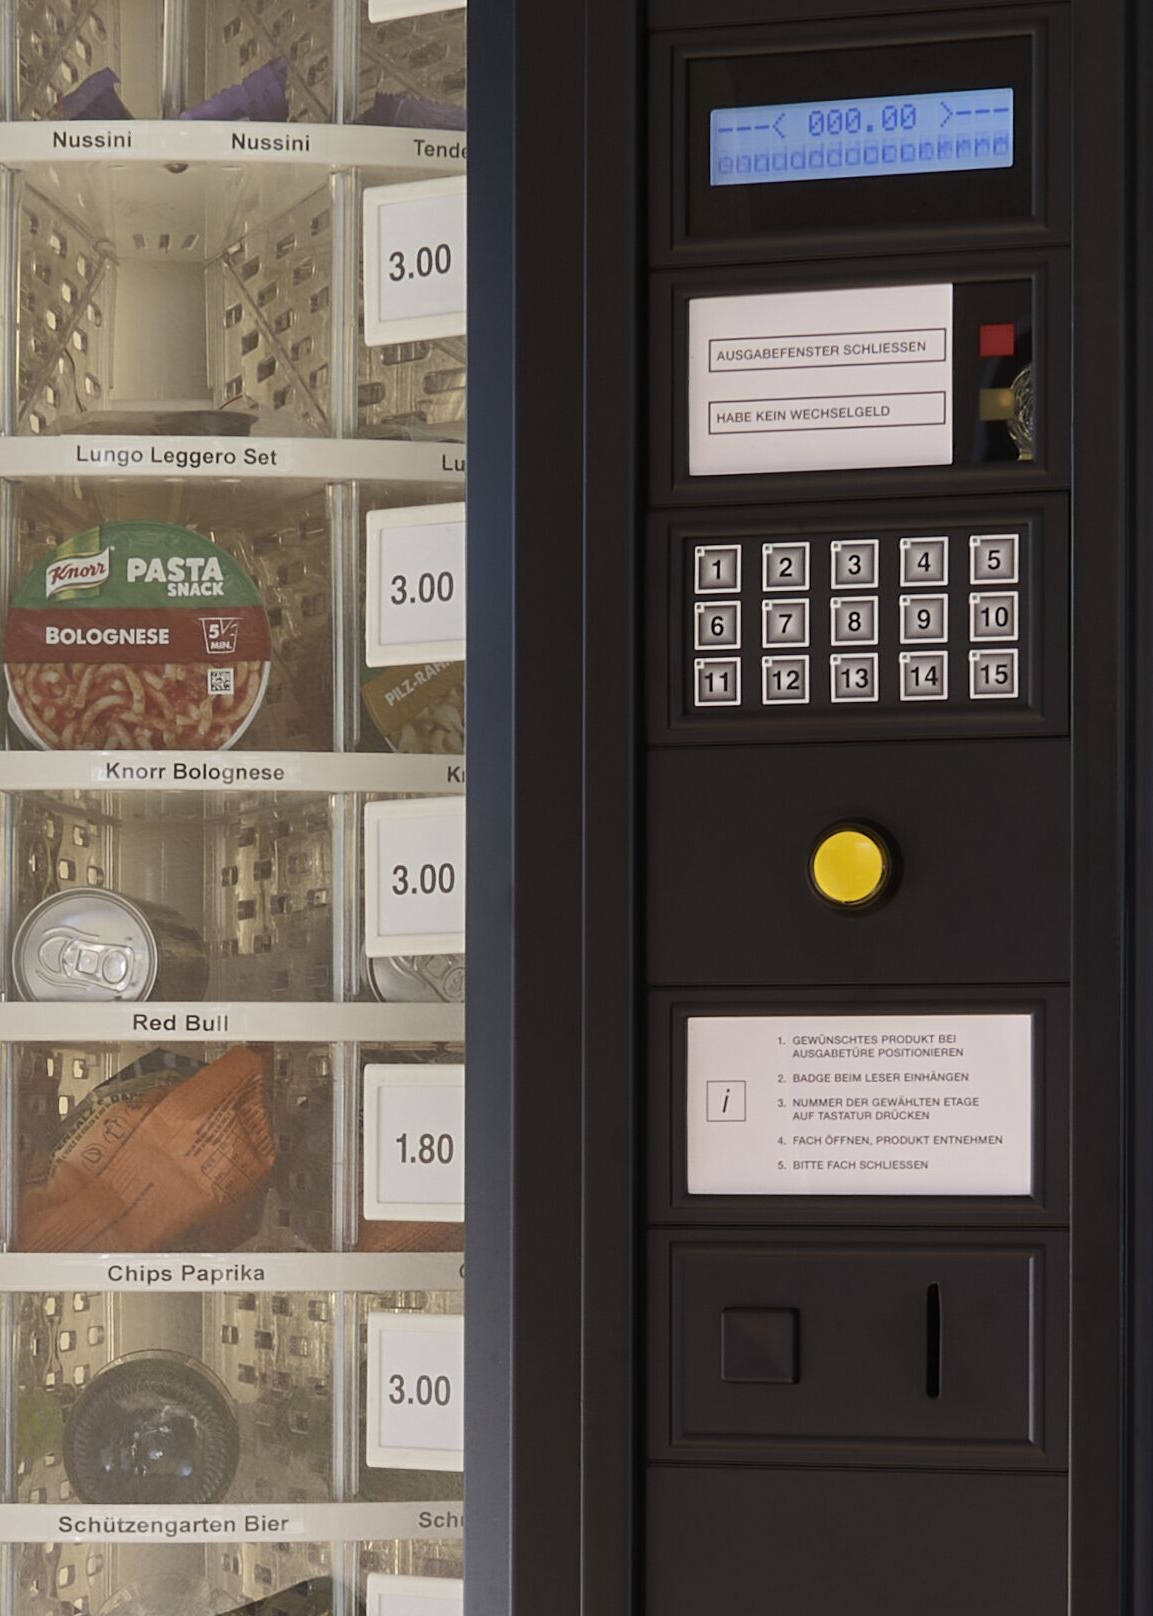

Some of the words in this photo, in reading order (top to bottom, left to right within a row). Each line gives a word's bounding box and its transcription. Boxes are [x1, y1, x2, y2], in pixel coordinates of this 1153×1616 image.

[808, 103, 916, 137] 000.00
[52, 131, 132, 148] Nussini
[231, 132, 310, 152] Nussini
[389, 244, 452, 282] 3.00
[716, 343, 840, 361] AUSGABEFENSTER
[842, 340, 927, 357] SCHLIESSEN
[716, 410, 752, 424] HABE
[755, 408, 787, 422] KEIN
[790, 404, 890, 421] WECHSELGELD
[76, 445, 144, 471] Lungo
[151, 446, 236, 470] Leggero
[243, 448, 277, 466] Set
[127, 557, 224, 582] PASTA
[712, 560, 722, 580] 1
[779, 558, 793, 577] 2
[848, 556, 862, 575] 3
[917, 552, 932, 572] 4
[987, 550, 1001, 570] 5
[48, 561, 107, 586] Knorr
[167, 582, 224, 597] SNACK
[390, 572, 454, 605] 3.00
[711, 616, 724, 636] 6
[778, 614, 793, 634] 7
[848, 612, 862, 632] 8
[917, 609, 931, 629] 9
[981, 607, 1009, 627] 10
[45, 626, 170, 645] BOLOGNESE
[208, 623, 220, 640] 5
[384, 660, 454, 707] PILZ-RAH
[704, 672, 729, 692] 11
[772, 670, 800, 691] 12
[841, 668, 869, 688] 13
[910, 666, 938, 686] 14
[980, 663, 1009, 684] 15
[106, 762, 166, 780] Knorr
[173, 762, 285, 785] Bolognese
[447, 766, 464, 783] K
[392, 863, 455, 895] 3.00
[133, 1013, 176, 1031] Red
[185, 1014, 229, 1032] Bull
[777, 1036, 786, 1045] 1.
[792, 1033, 878, 1046] GEWÜNSCHTES
[881, 1034, 935, 1045] PRODUKT
[938, 1034, 957, 1044] BEI
[792, 1046, 875, 1059] AUSGABETÜRE
[877, 1047, 964, 1058] POSITIONIEREN
[777, 1073, 787, 1083] 2.
[792, 1073, 831, 1083] BADGE
[834, 1073, 862, 1083] BEIM
[864, 1072, 901, 1083] LESER
[903, 1070, 969, 1083] EINHÄNGEN
[777, 1098, 787, 1108] 3.
[792, 1097, 843, 1108] NUMMER
[846, 1097, 869, 1108] DER
[871, 1095, 940, 1108] GEWÄHLTEN
[943, 1097, 980, 1107] ETAGE
[792, 1111, 815, 1121] AUF
[817, 1110, 872, 1121] TASTATUR
[875, 1108, 930, 1121] DRÜCKEN
[395, 1133, 454, 1164] 1.80
[777, 1136, 787, 1145] 4.
[792, 1135, 822, 1146] FACH
[824, 1133, 873, 1147] ÖFFNEN,
[875, 1135, 930, 1145] PRODUKT
[933, 1135, 1003, 1145] ENTNEHMEN
[777, 1160, 787, 1170] 5.
[792, 1160, 824, 1170] BITTE
[827, 1160, 857, 1170] FACH
[859, 1160, 929, 1170] SCHLIESSEN
[107, 1264, 173, 1286] Chips
[181, 1264, 266, 1286] Paprika
[388, 1374, 451, 1407] 3.00
[58, 1515, 236, 1538] Schützengarten
[244, 1514, 289, 1532] Bier
[418, 1511, 464, 1528] Sch
